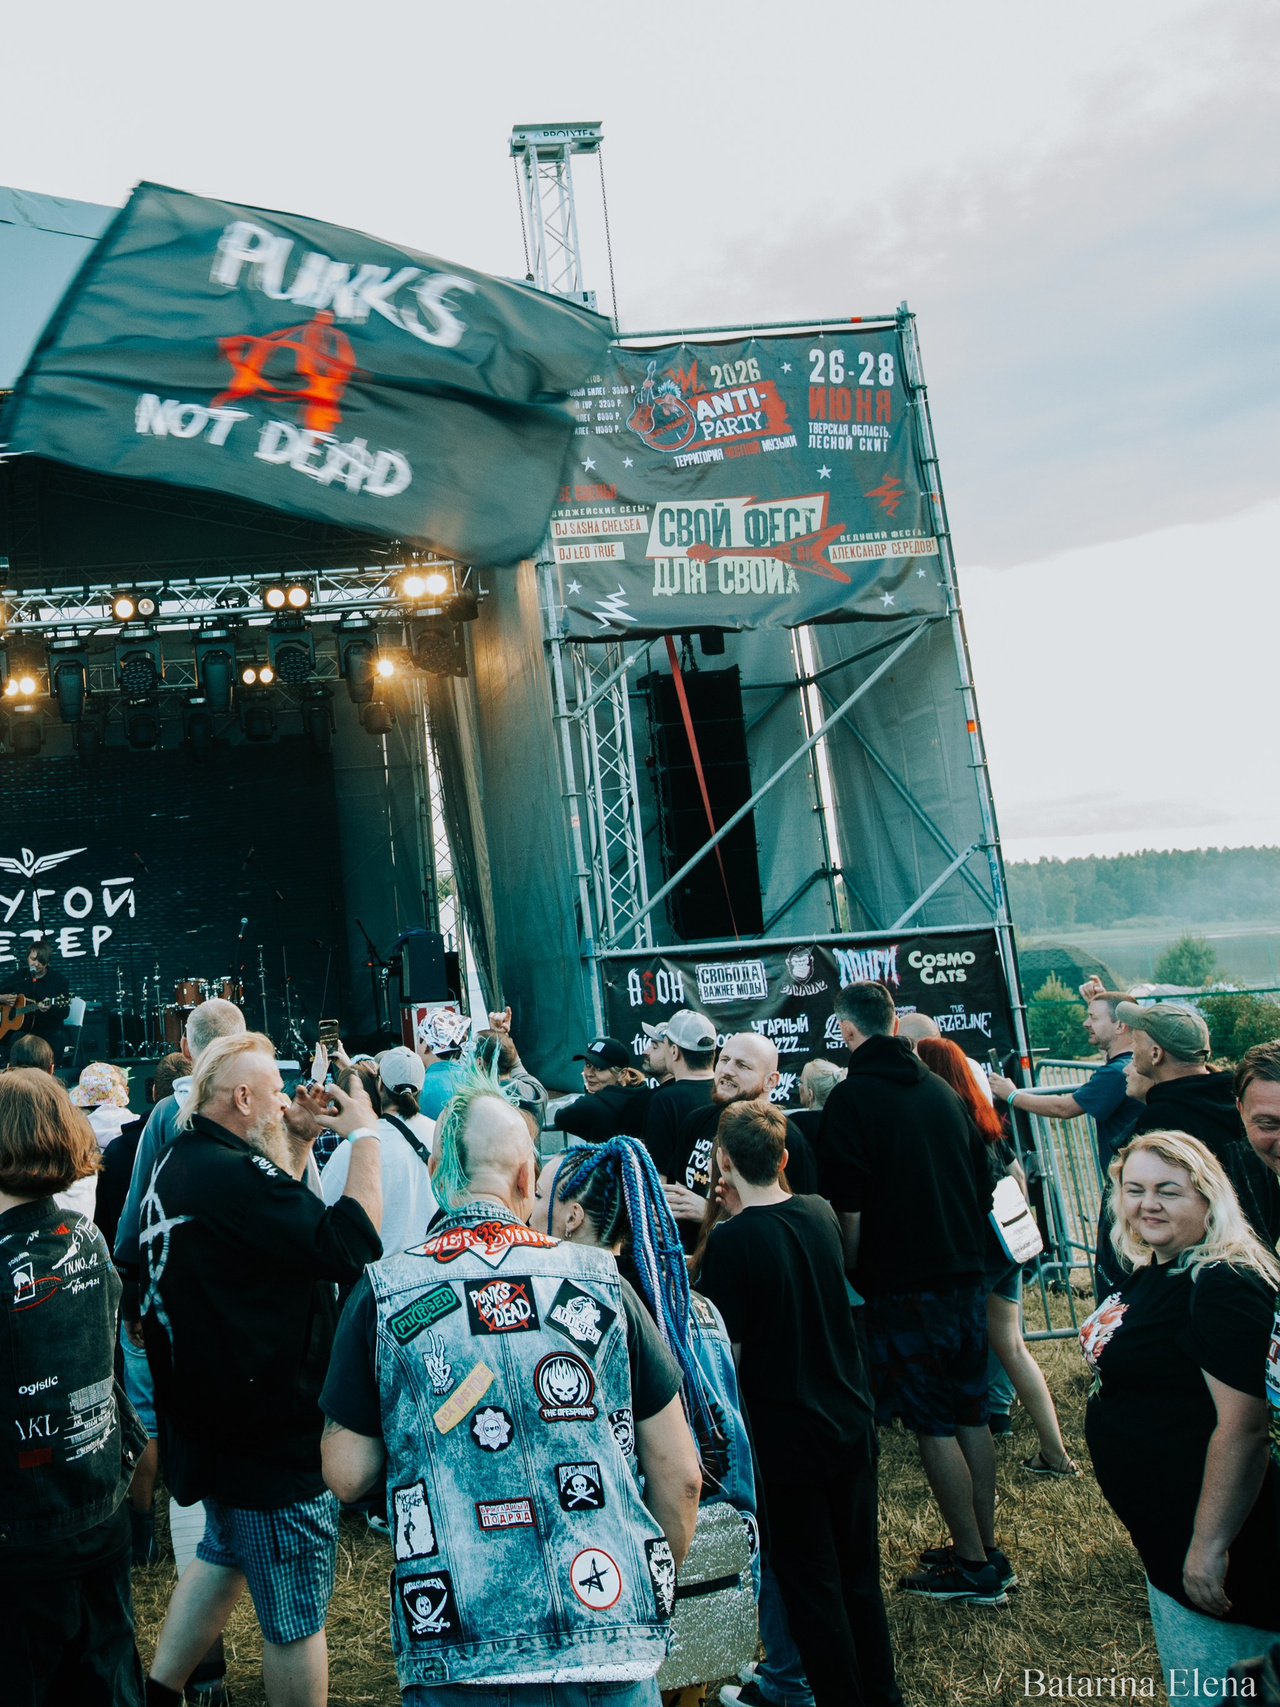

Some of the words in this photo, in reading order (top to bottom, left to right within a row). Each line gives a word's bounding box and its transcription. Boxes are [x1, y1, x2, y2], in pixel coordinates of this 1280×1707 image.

[209, 220, 481, 349] PUNKS
[710, 357, 761, 389] 2026
[808, 386, 891, 423] ИЮНЯ
[700, 411, 762, 441] PARTY
[808, 422, 849, 435] ТВЕРСКАЯ
[135, 393, 254, 447] NOT
[254, 419, 413, 497] DEAD
[673, 448, 724, 468] ТЕРРИТОРИЯ
[761, 435, 797, 453] МУЗЫКИ
[808, 435, 853, 451] ЛЕСНОЙ
[859, 437, 888, 453] СКИТ
[551, 506, 616, 518] ДИДЖЕЙСКИЕ
[555, 522, 568, 536] DJ
[570, 520, 600, 535] SASHA
[601, 518, 641, 533] CHELSEA
[658, 502, 732, 547] СВОЙ
[744, 507, 817, 547] ФЕСТ
[840, 530, 888, 543] ВЕДУЩИЙ
[559, 547, 572, 561] DJ
[574, 546, 591, 559] LEO
[593, 544, 616, 558] TRUE
[832, 543, 887, 560] АЛЕКСАНДР
[652, 557, 707, 596] ДЛЯ
[718, 558, 801, 595] СВОИХ
[701, 965, 761, 984] СВОБОДА
[704, 983, 735, 998] ВАЖНЕЕ
[736, 981, 762, 995] МОДЫ
[950, 1004, 965, 1013] THE
[751, 1014, 809, 1035] УГАРНЫЙ
[423, 1221, 560, 1262] AEROSMITH
[469, 1282, 511, 1308] PUNKS
[480, 1501, 529, 1514] БРИГАДНЫЙ
[483, 1511, 531, 1526] ПОДРЯД
